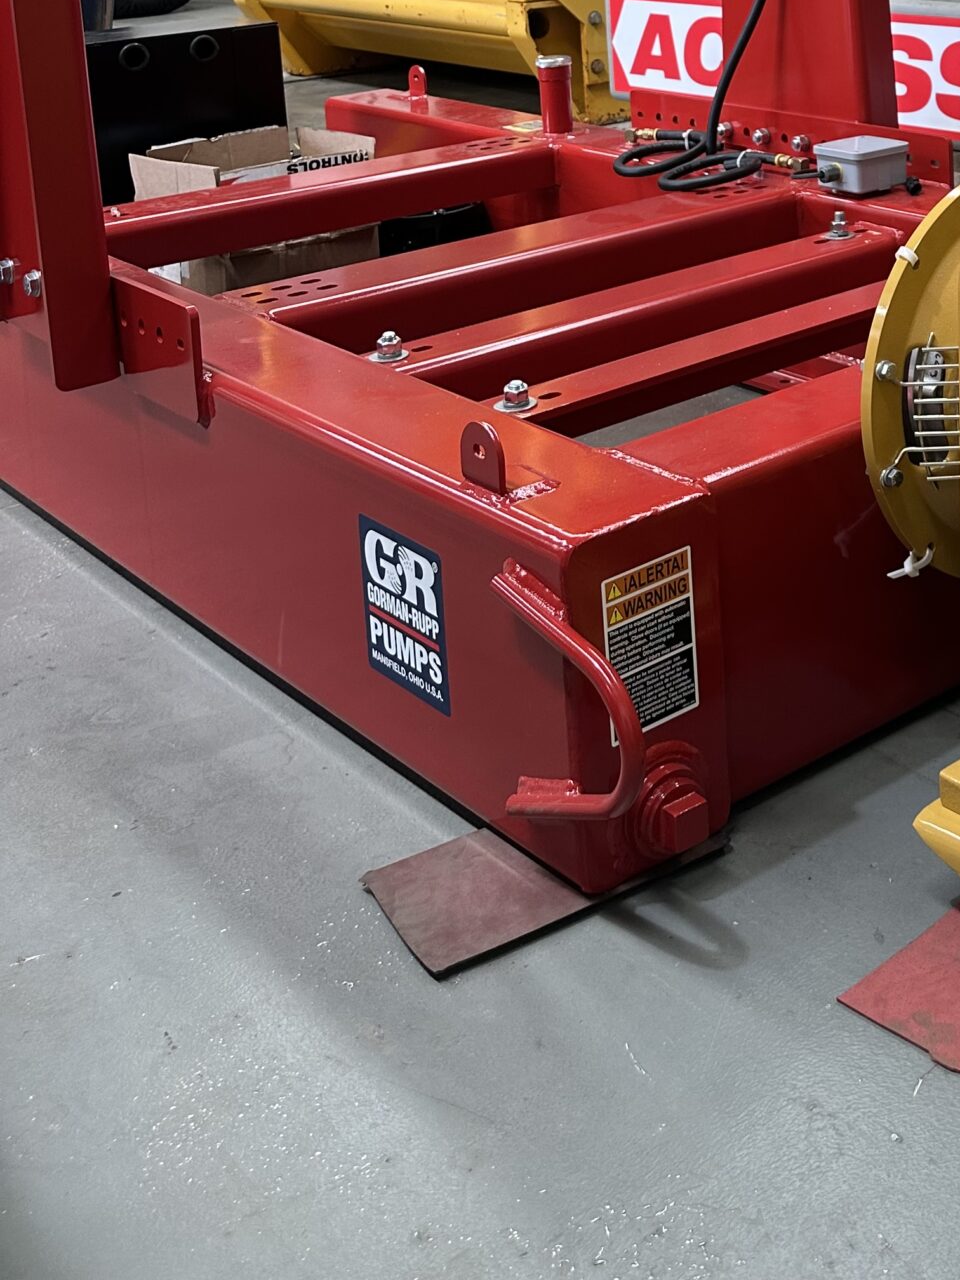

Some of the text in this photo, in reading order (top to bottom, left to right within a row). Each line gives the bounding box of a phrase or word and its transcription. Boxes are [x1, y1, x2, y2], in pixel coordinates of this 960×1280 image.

[367, 581, 440, 640] GORMAN-RUPP
[623, 577, 688, 618] WARNING
[369, 614, 443, 686] PUMPS
[372, 647, 444, 702] MANSFIELD, OHIO U.S.A.
